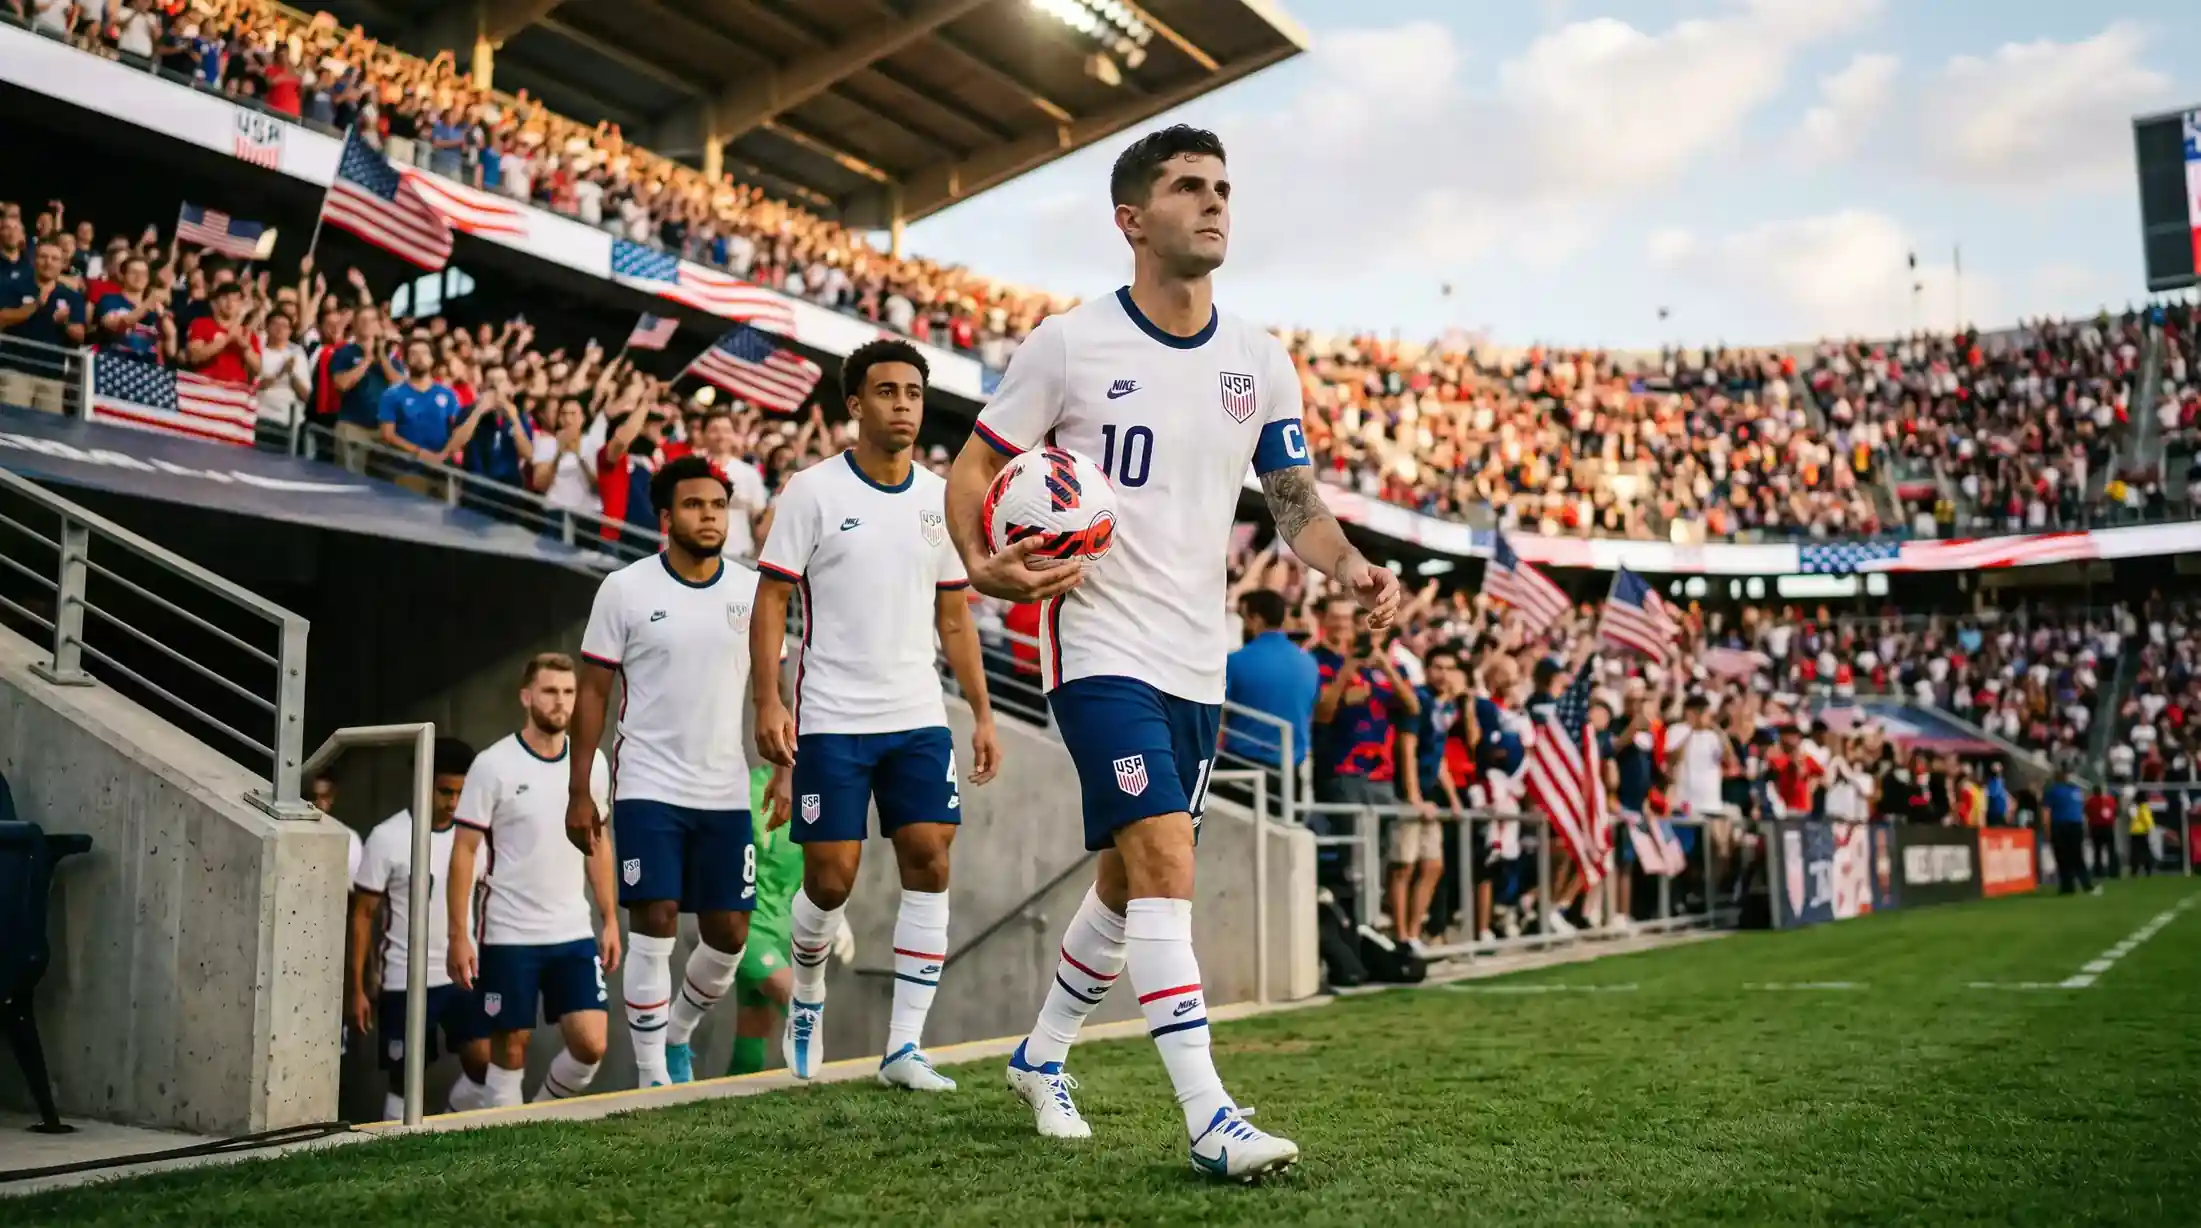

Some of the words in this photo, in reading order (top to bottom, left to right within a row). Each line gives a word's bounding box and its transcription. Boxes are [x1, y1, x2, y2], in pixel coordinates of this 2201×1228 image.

[1112, 379, 1137, 391] NIKE
[1223, 375, 1252, 395] USA
[1102, 424, 1154, 488] 10
[1282, 423, 1306, 459] C
[946, 748, 958, 794] 4
[1115, 757, 1142, 774] USA
[742, 843, 757, 884] 8
